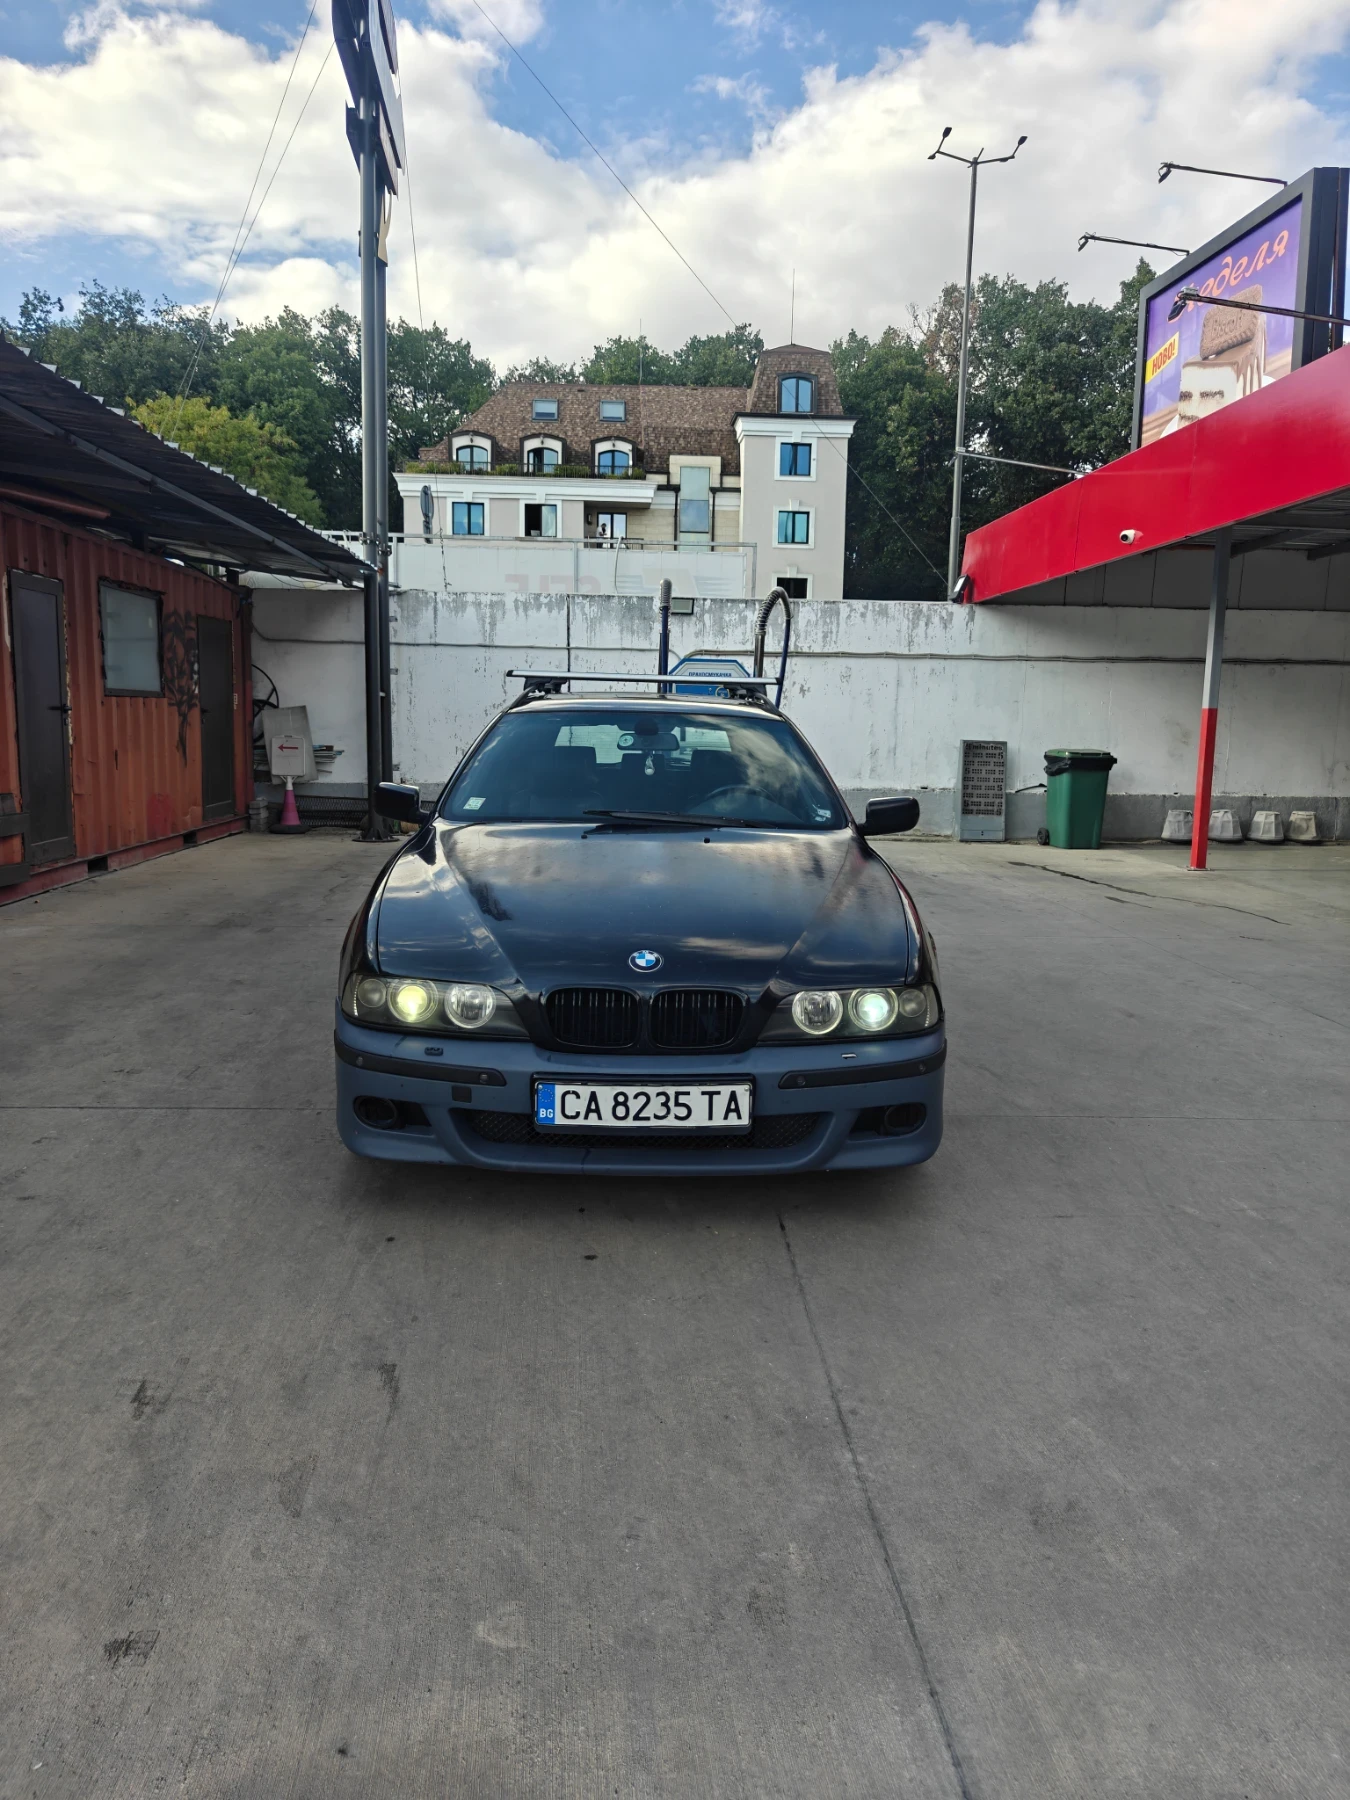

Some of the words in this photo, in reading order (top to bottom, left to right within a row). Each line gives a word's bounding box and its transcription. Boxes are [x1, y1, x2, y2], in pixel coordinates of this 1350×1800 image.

[1152, 338, 1176, 376] НОВО!
[972, 743, 1003, 751] minutes
[539, 1108, 554, 1119] BG
[560, 1089, 603, 1121] CA
[611, 1091, 693, 1121] 8235
[700, 1090, 743, 1121] TA
